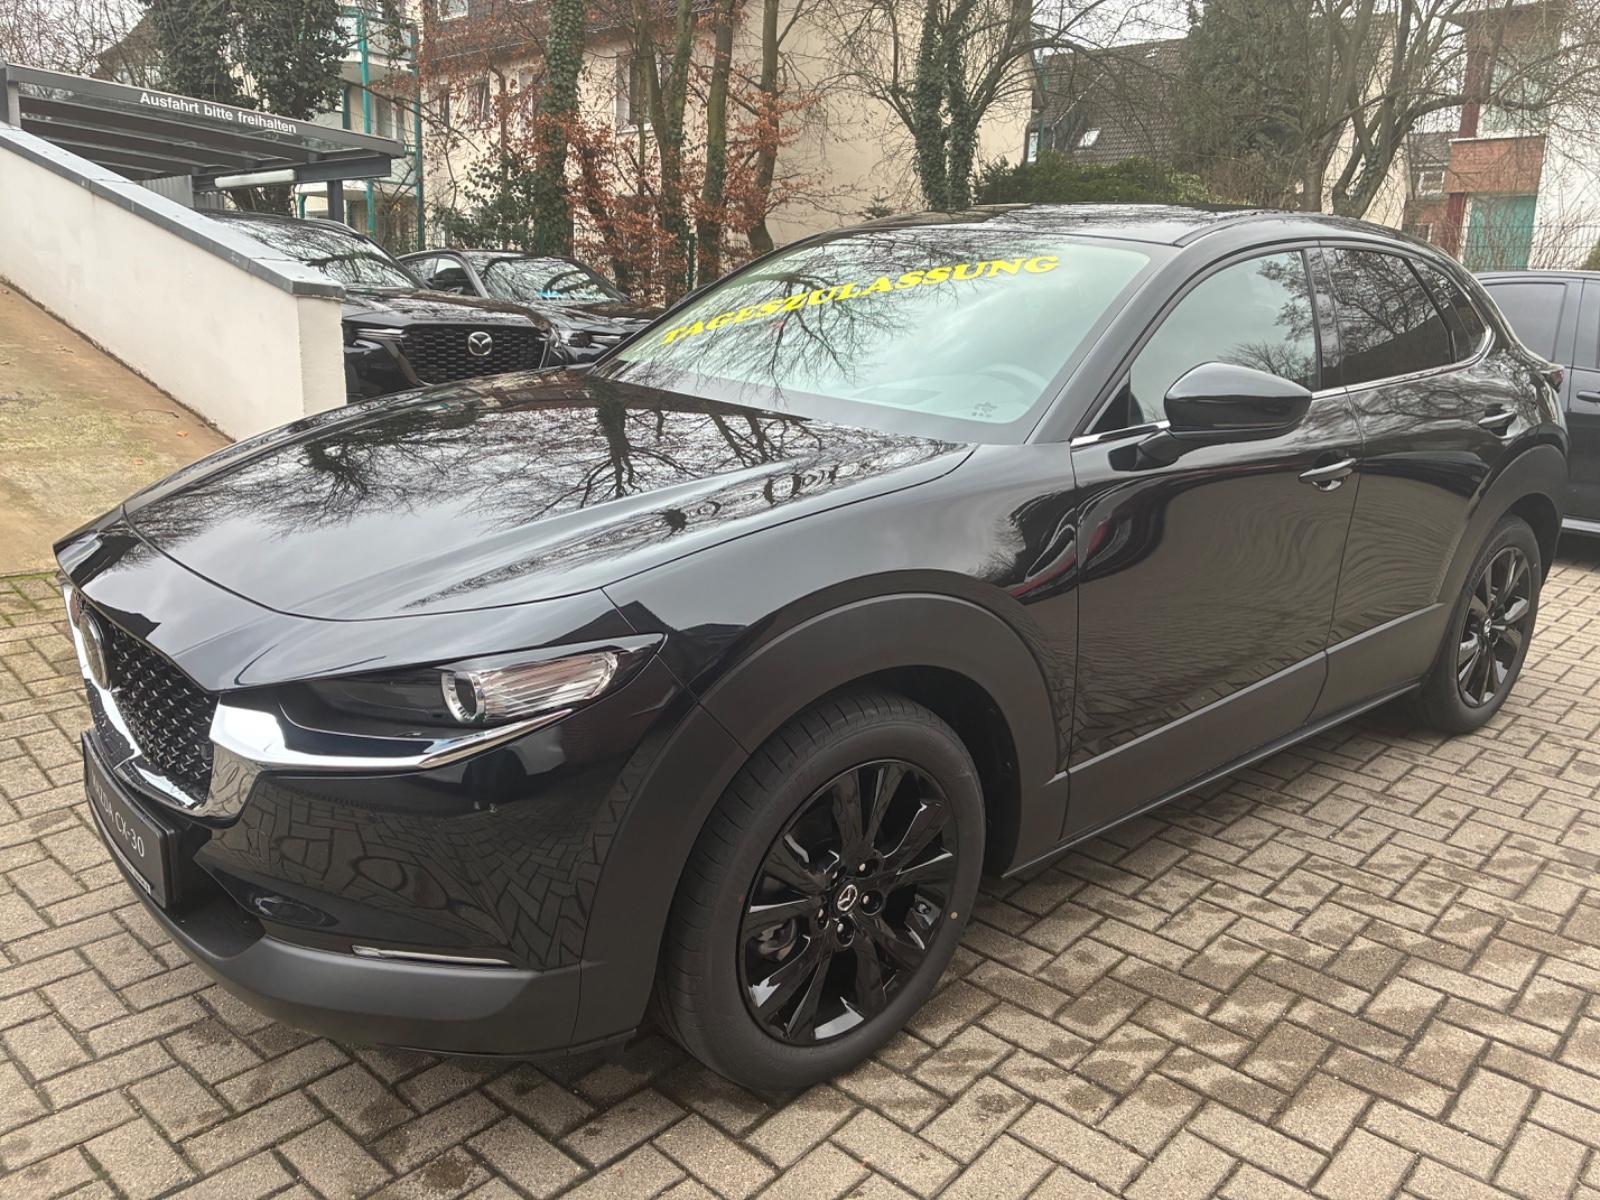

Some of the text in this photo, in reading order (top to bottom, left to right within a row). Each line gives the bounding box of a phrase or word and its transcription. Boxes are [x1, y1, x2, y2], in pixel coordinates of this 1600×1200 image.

[140, 91, 297, 134] Ausfahrt bitte freihalten
[661, 256, 1059, 347] TAGESZULASSUNG
[115, 811, 145, 858] CX-30
